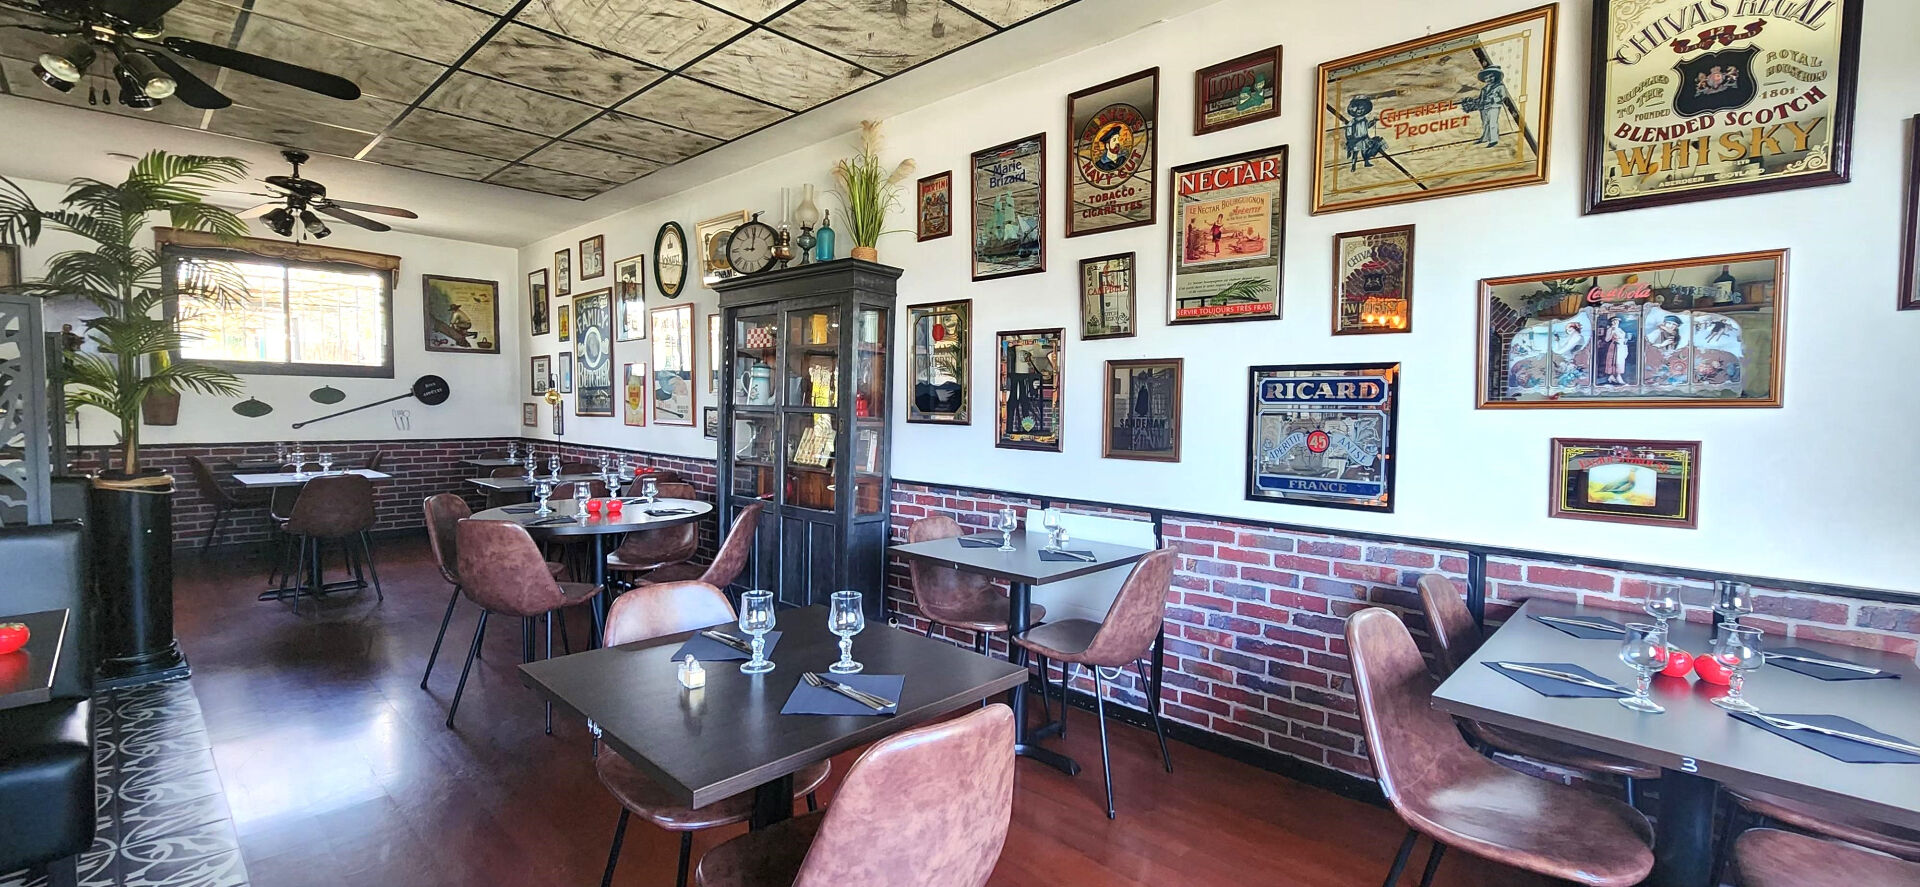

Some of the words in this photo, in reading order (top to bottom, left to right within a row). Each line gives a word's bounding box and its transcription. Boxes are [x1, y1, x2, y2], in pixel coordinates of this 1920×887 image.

[1608, 0, 1729, 65] CHIVAS
[1710, 26, 1725, 36] 12
[1766, 49, 1823, 67] ROYAL
[1766, 64, 1827, 82] HOUSEHOLD
[1617, 75, 1669, 104] SUPPLIED
[1617, 104, 1635, 118] TO
[1636, 88, 1664, 107] THE
[1614, 113, 1715, 142] BLENDED
[1725, 86, 1827, 126] SCOTCH
[1634, 109, 1670, 121] FOUNDED
[1394, 115, 1470, 140] PROCHET
[1612, 117, 1825, 177] WHISKY
[993, 160, 1022, 176] Marie
[1082, 160, 1114, 185] NAVY
[1117, 149, 1141, 179] CUT
[990, 169, 1026, 188] Brizard
[1181, 159, 1280, 194] NECTAR
[1089, 187, 1135, 204] TOBACCO
[1082, 201, 1143, 219] CIGARETTES
[1199, 306, 1235, 315] TOUJOURS
[1254, 303, 1273, 311] FRAIS
[577, 308, 608, 334] FAMILY
[578, 358, 610, 388] BUTCHER
[1266, 382, 1380, 399] RICARD
[1309, 436, 1327, 449] 45
[1288, 480, 1347, 492] FRANCE
[1681, 757, 1698, 772] 3
